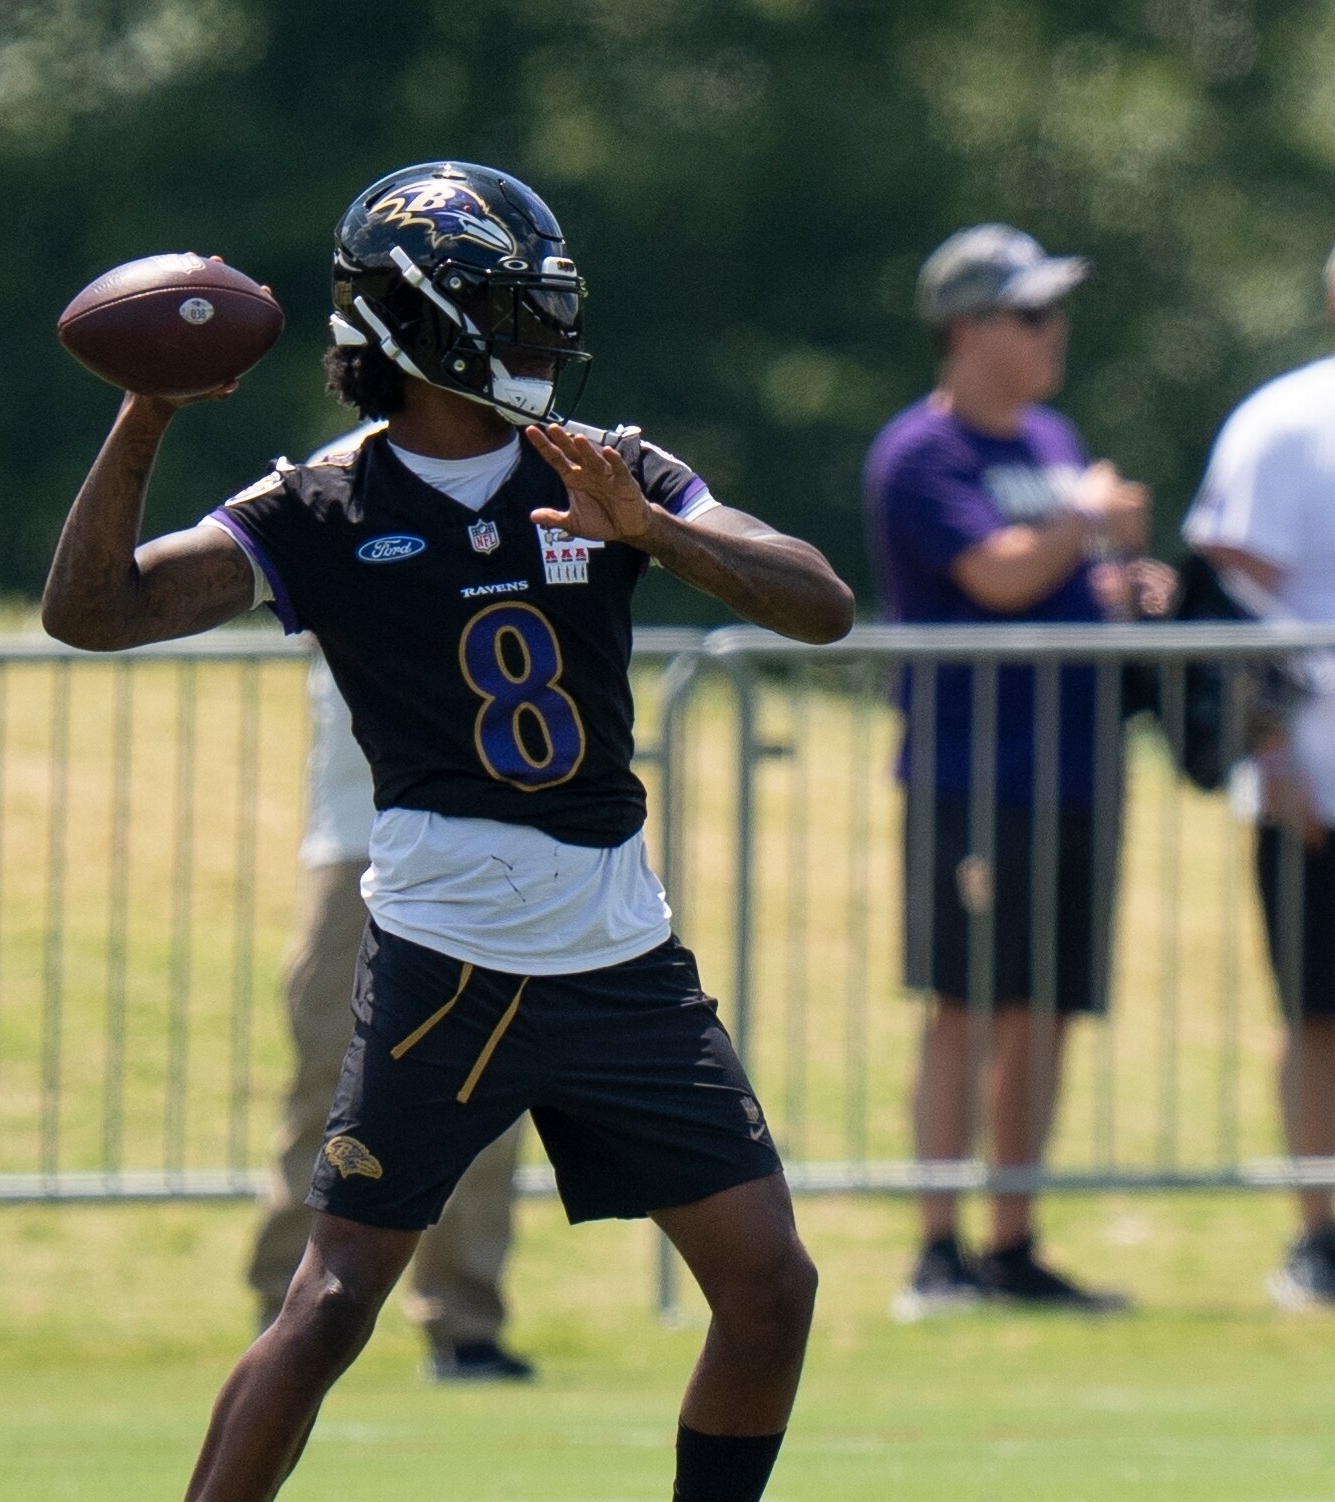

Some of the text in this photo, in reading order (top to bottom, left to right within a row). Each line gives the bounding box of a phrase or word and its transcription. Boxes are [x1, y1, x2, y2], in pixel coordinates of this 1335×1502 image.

[371, 540, 412, 557] Ford
[460, 580, 529, 598] RAVENS
[459, 601, 586, 792] 8
